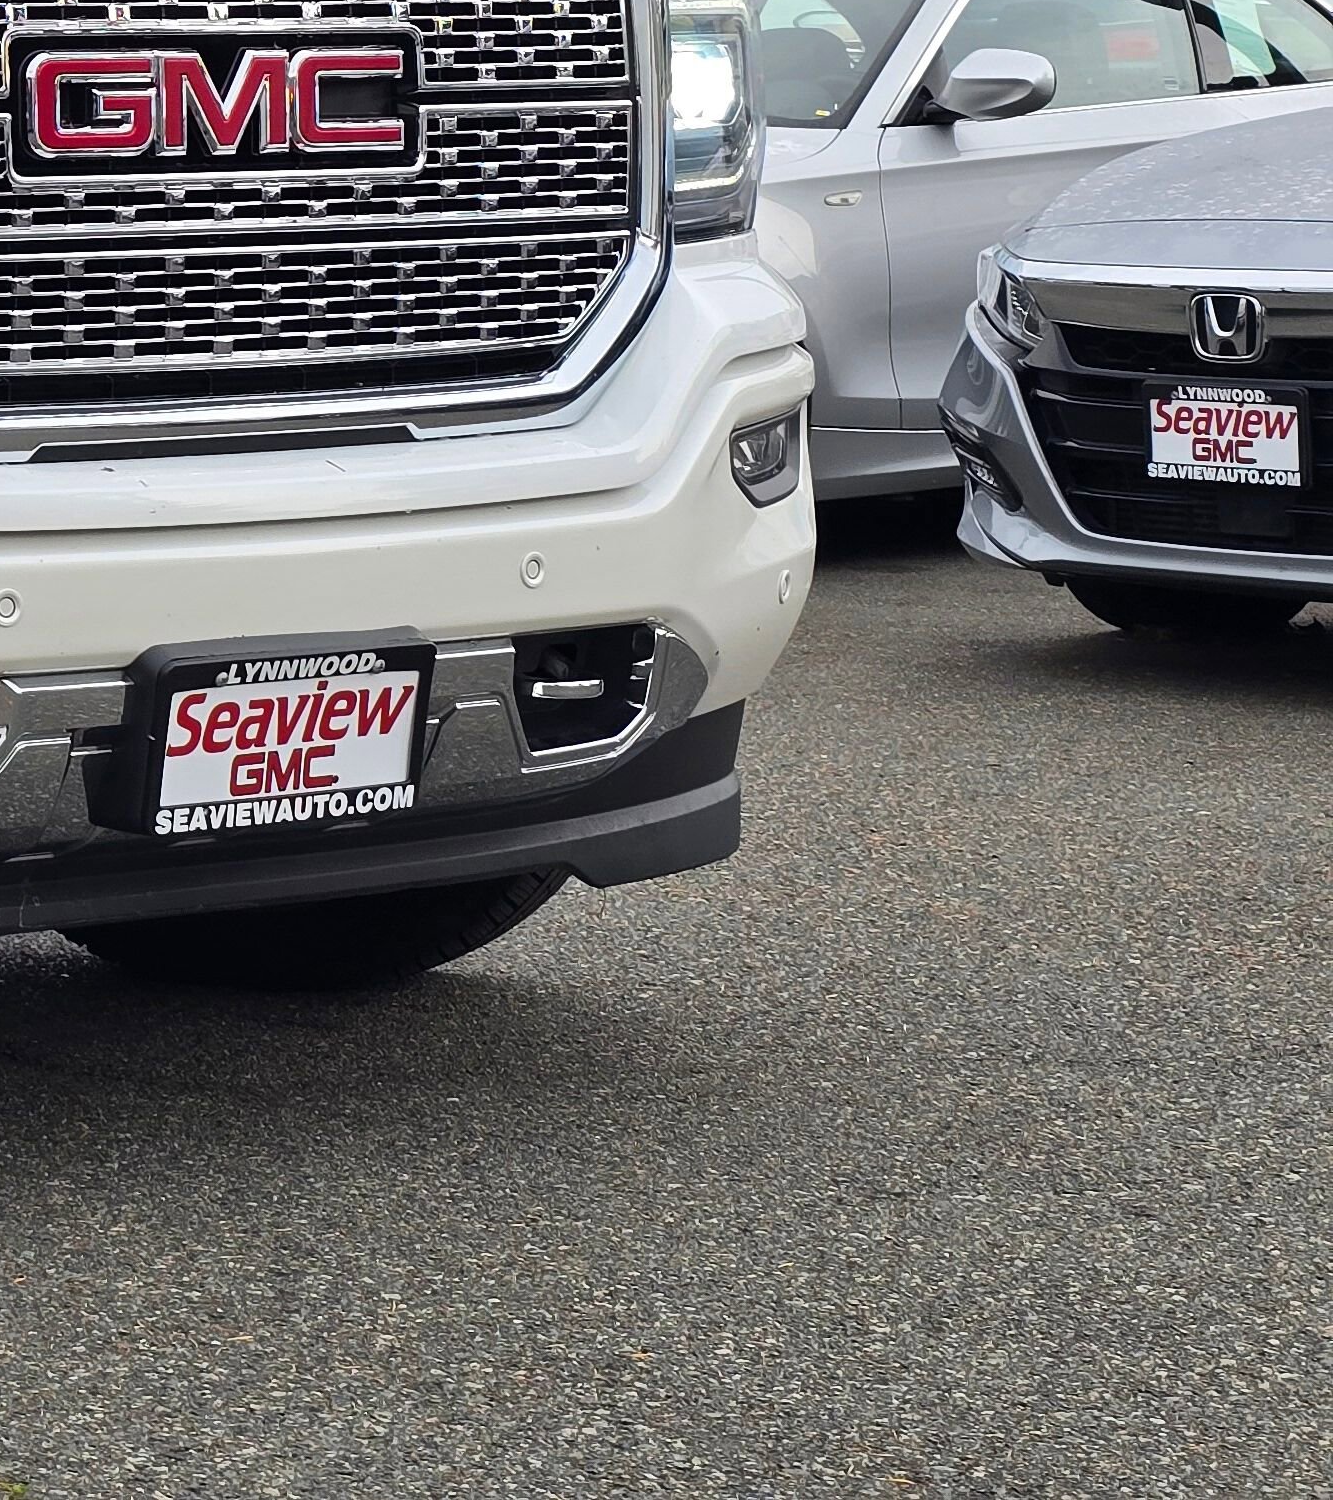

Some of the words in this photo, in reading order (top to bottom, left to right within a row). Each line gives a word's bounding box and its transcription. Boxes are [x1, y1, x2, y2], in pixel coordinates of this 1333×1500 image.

[28, 49, 404, 158] GMC
[1177, 385, 1266, 403] LYNNWOOD
[1153, 399, 1297, 439] Seaview
[1192, 437, 1257, 464] GMC
[1147, 462, 1301, 487] SEAVIEWAUTO.COM
[227, 652, 377, 684] LYNNWOOD
[166, 680, 414, 757] Seaview
[229, 744, 338, 796] GMC
[155, 785, 414, 835] SEAVIEWAUTO.COM
